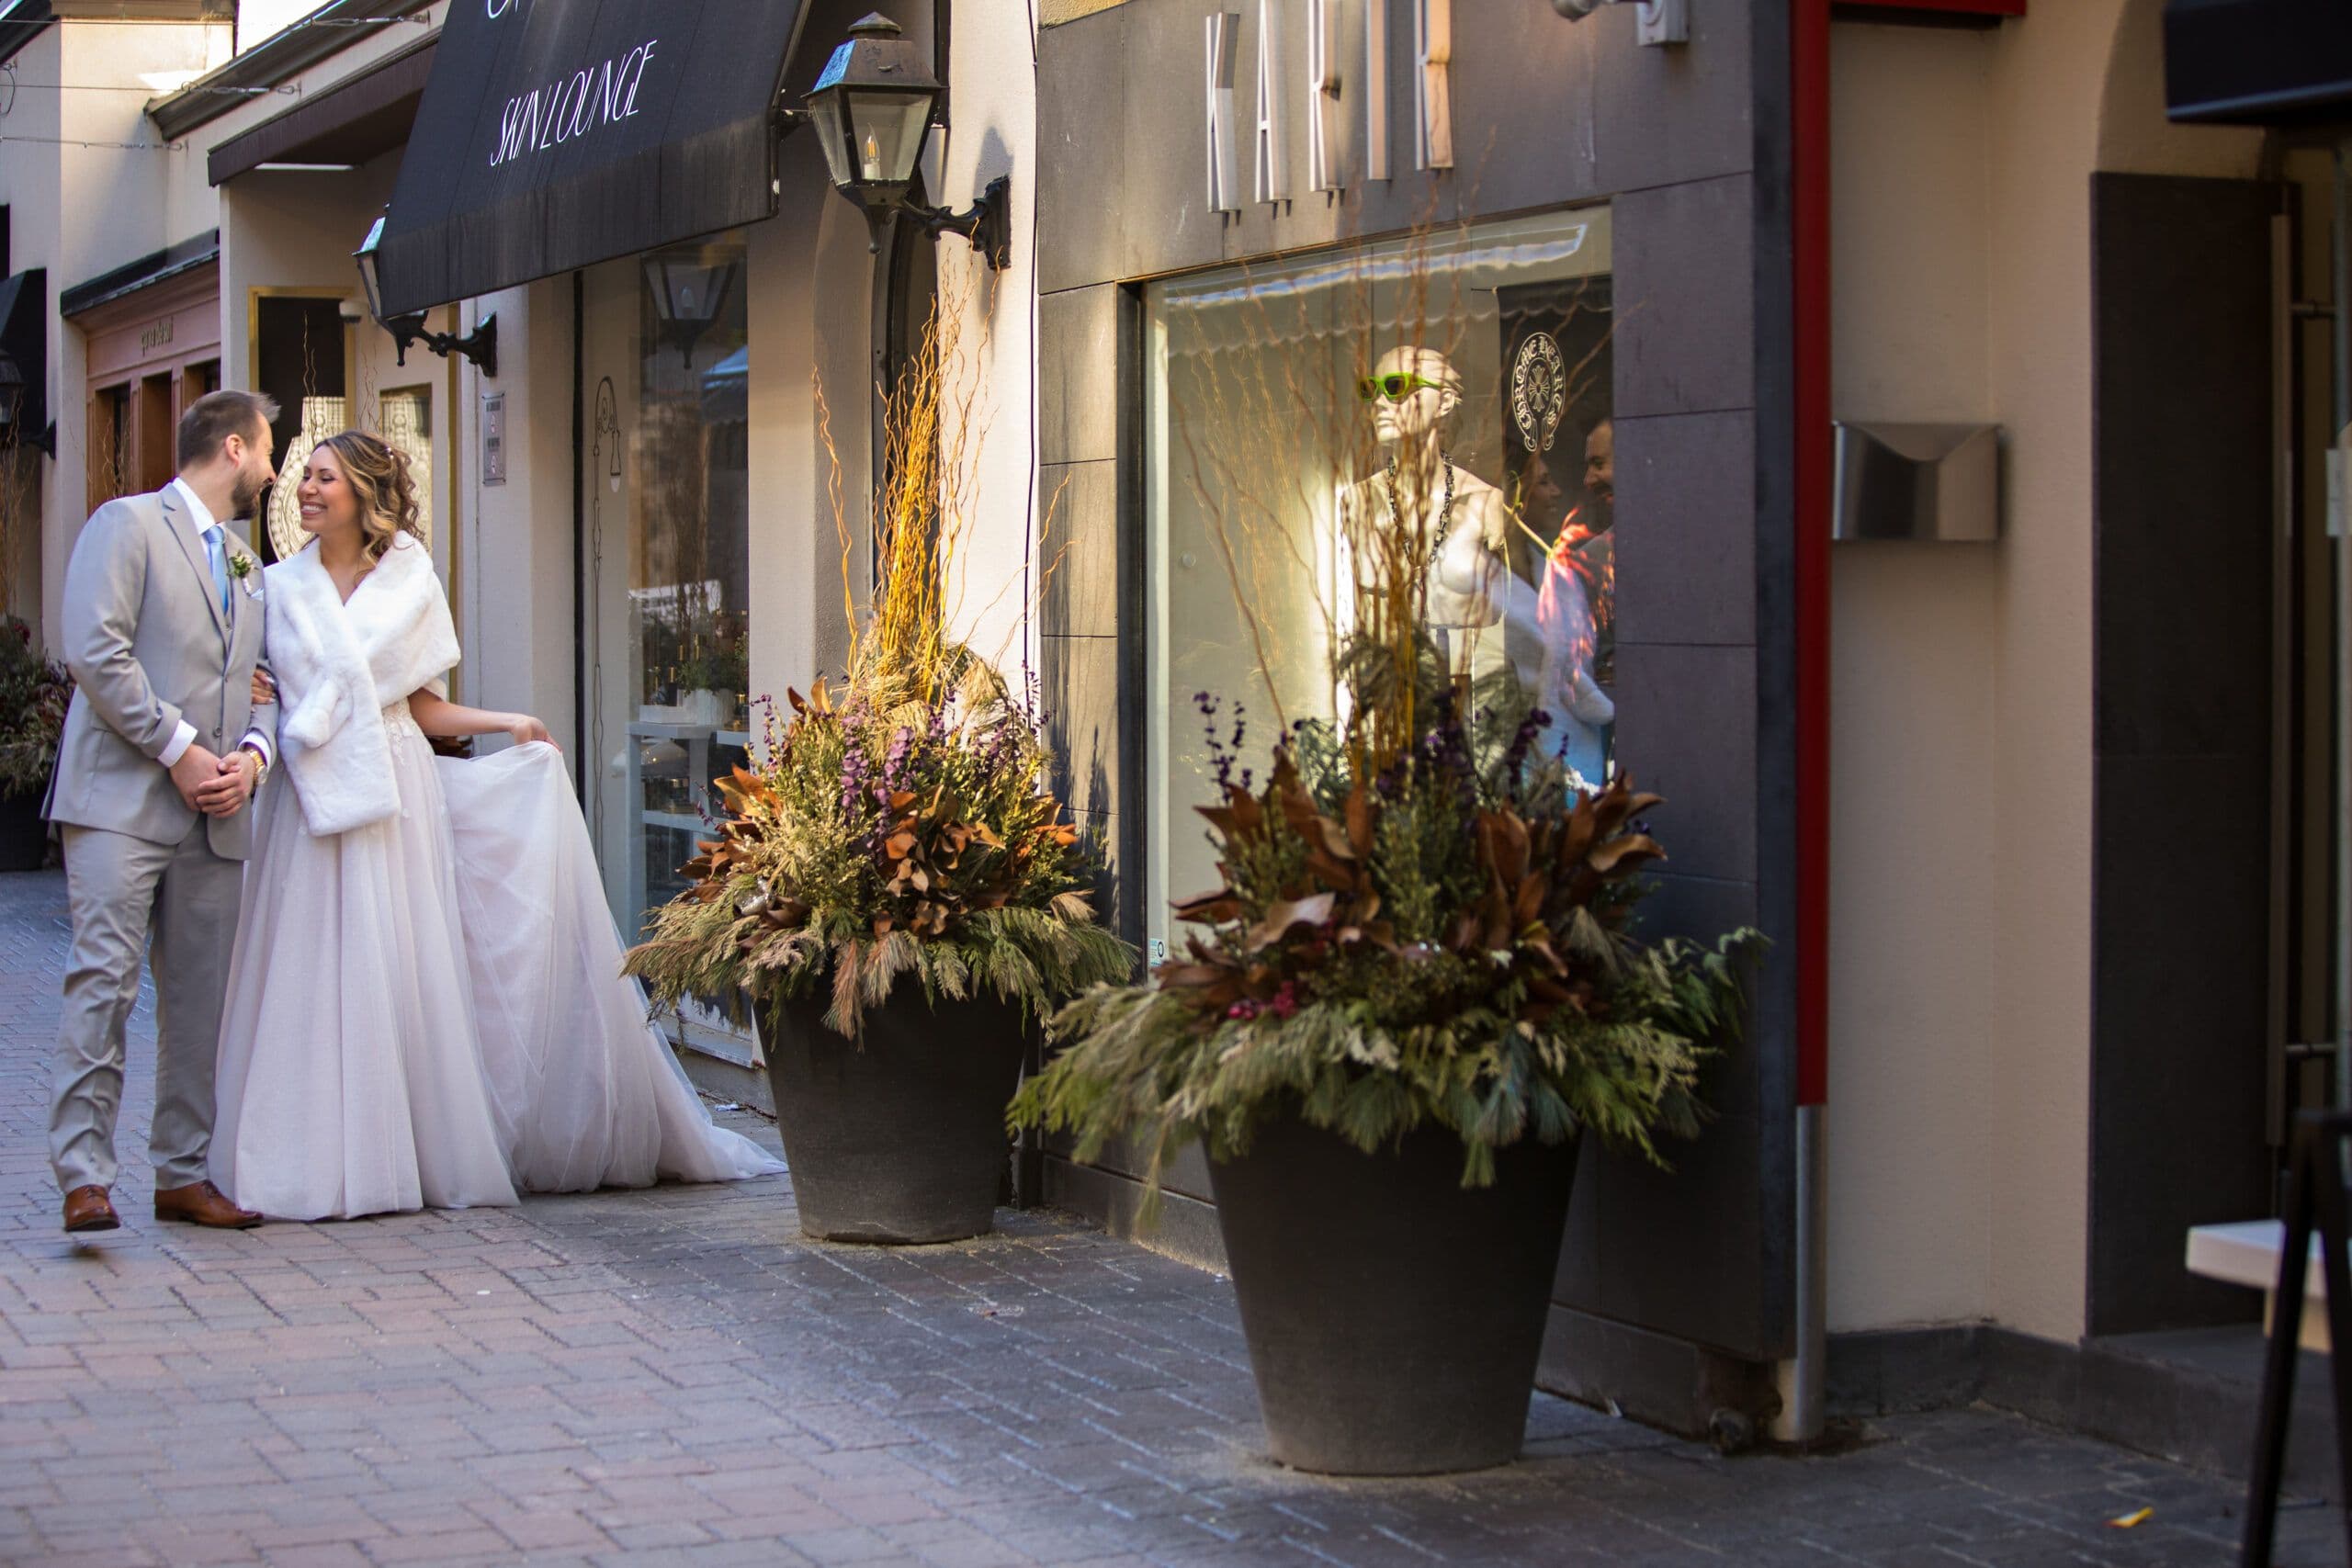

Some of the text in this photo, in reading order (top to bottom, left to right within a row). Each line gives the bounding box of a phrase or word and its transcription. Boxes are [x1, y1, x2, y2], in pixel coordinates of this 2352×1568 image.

[490, 39, 657, 166] SKIN LOUNGE
[1205, 0, 1453, 212] KARIR
[1514, 339, 1538, 430] CHROME
